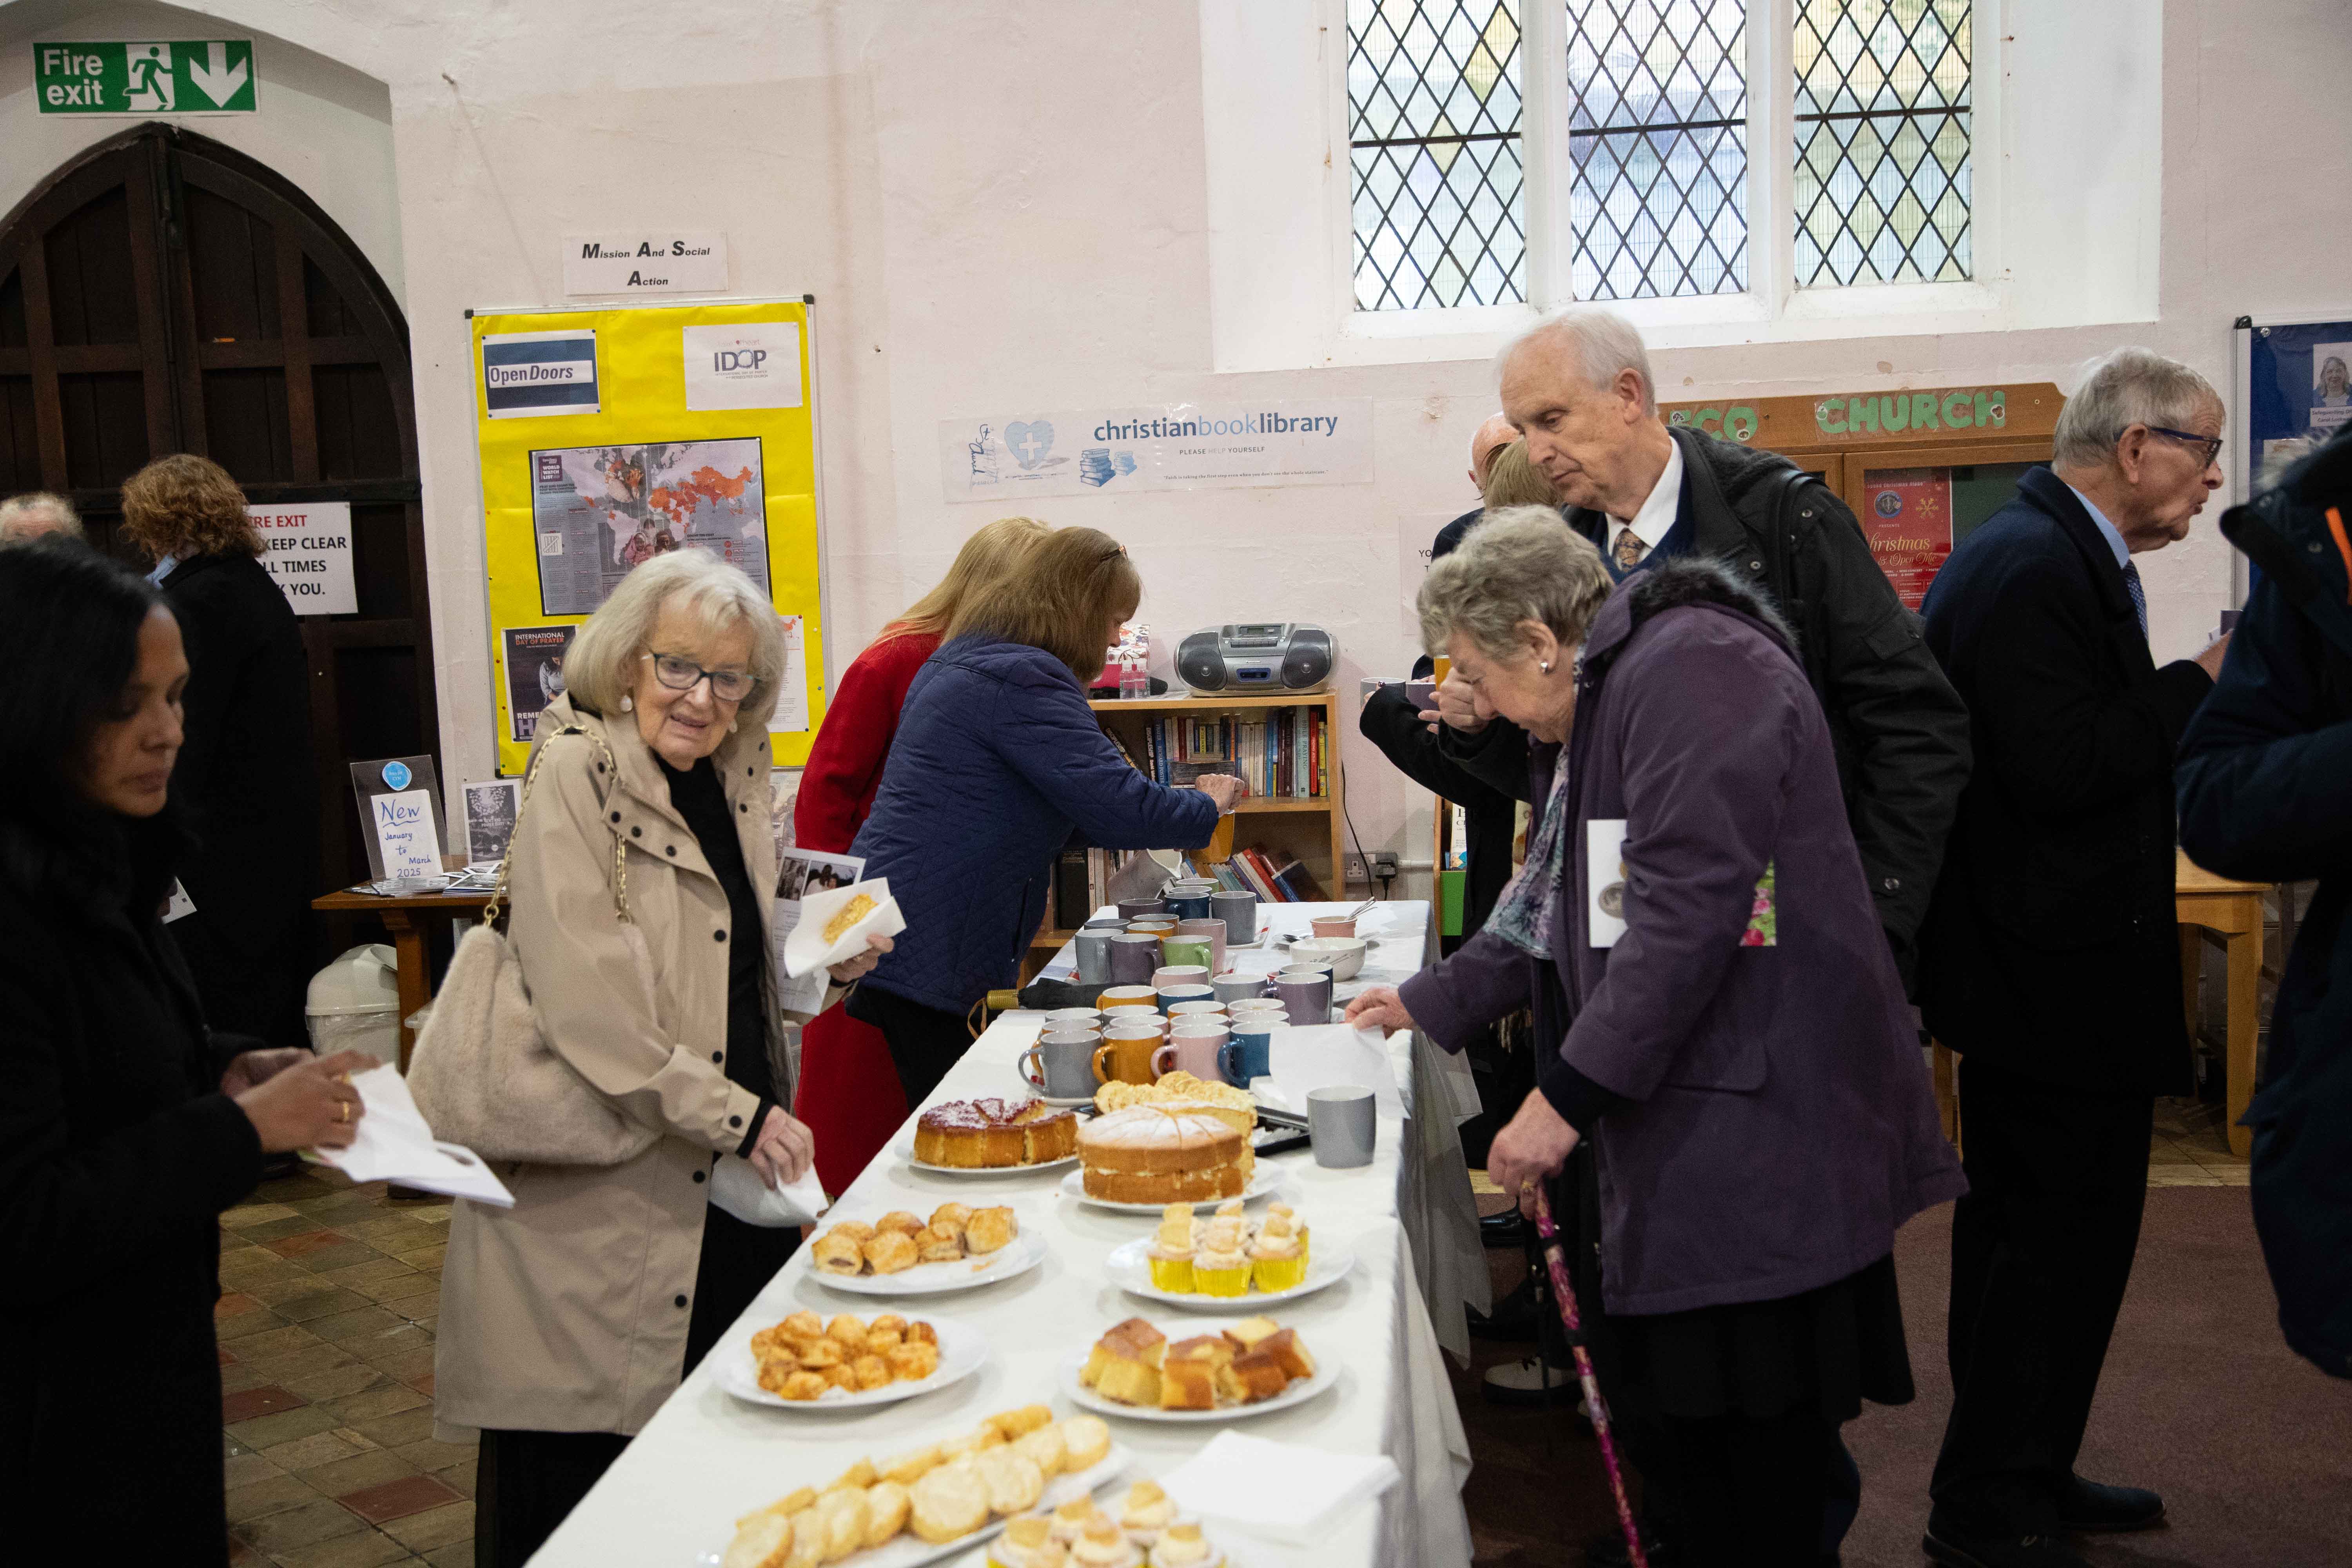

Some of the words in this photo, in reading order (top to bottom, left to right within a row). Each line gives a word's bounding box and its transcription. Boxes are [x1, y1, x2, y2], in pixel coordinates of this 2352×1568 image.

[44, 49, 103, 76] Fire
[47, 78, 104, 105] exit
[582, 243, 630, 259] Mission
[636, 242, 664, 257] And
[671, 240, 710, 256] Social
[627, 271, 668, 286] Action
[714, 349, 767, 372] IDOP
[1816, 390, 2005, 434] CHURCH
[969, 443, 985, 475] Church
[253, 515, 272, 528] RE
[276, 515, 307, 527] EXIT
[301, 537, 347, 550] CLEAR
[1866, 532, 1930, 553] hristmas
[1890, 552, 1914, 566] Open
[1916, 552, 1937, 565] Mic
[263, 561, 278, 573] LL
[282, 560, 327, 573] TIMES
[290, 583, 325, 595] YOU.
[515, 632, 565, 640] INTERNATIONAL
[381, 799, 420, 822] New
[385, 831, 413, 842] January
[395, 844, 408, 855] to
[409, 854, 432, 864] March
[397, 867, 421, 878] 2025
